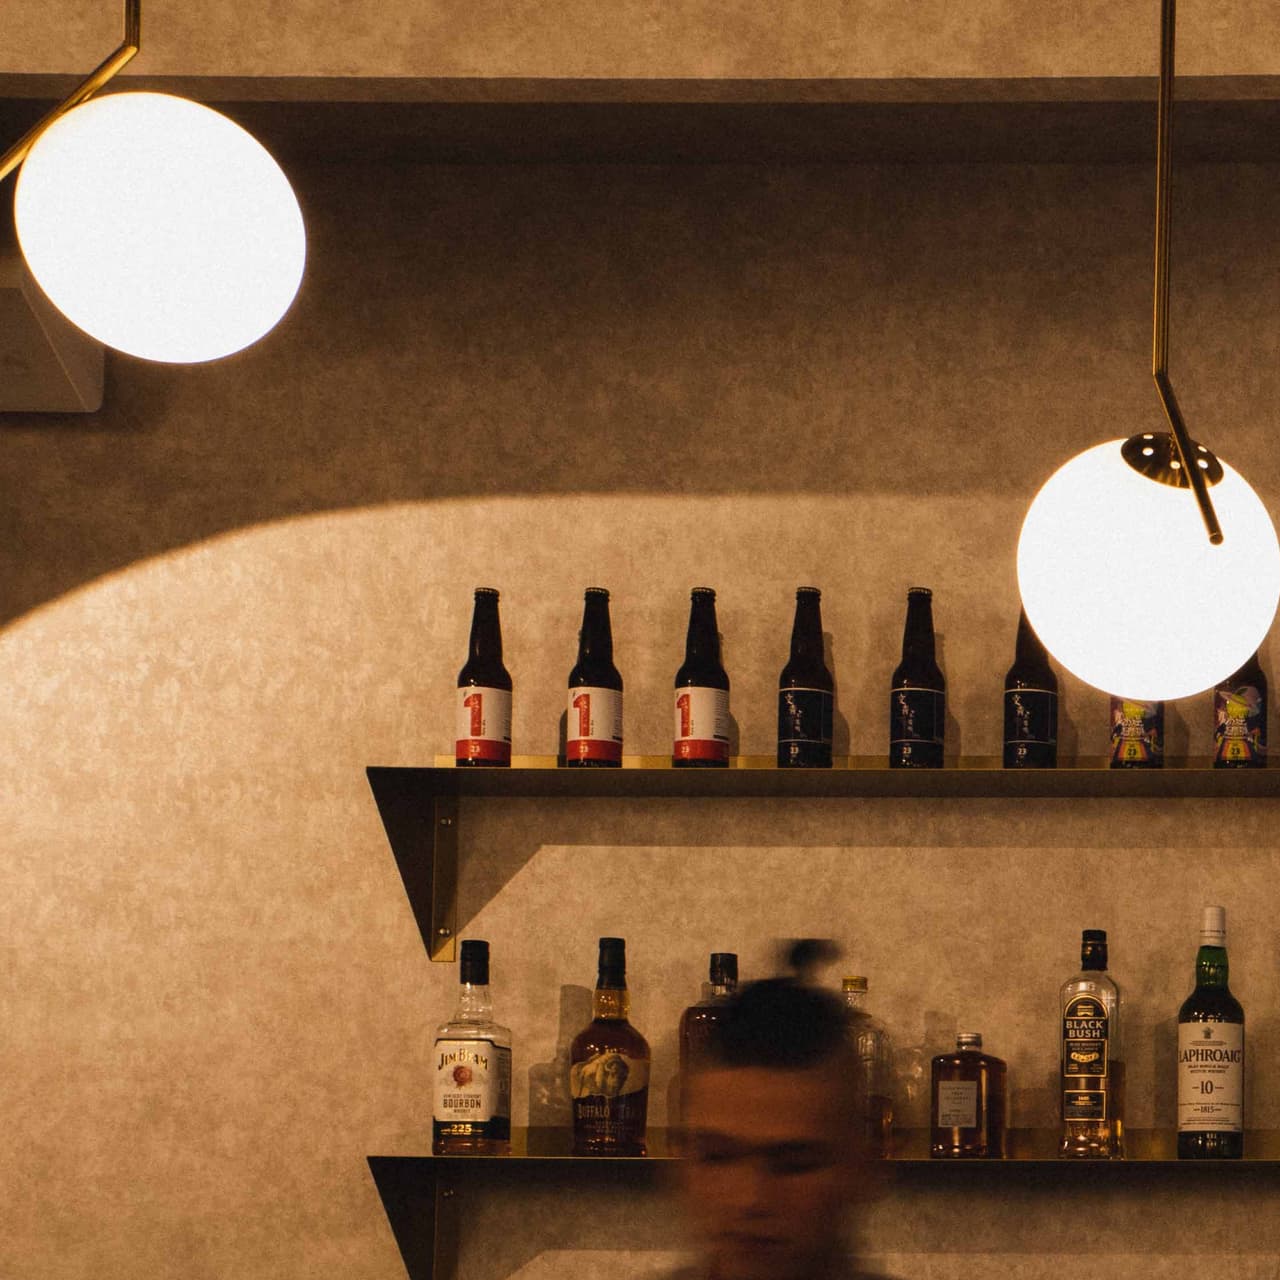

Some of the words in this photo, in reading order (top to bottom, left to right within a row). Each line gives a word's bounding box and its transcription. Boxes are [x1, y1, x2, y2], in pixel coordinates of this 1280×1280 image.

[1066, 1020, 1103, 1030] BLACK
[1069, 1030, 1100, 1038] BUSH
[438, 1053, 456, 1070] JIM
[458, 1048, 488, 1070] BEAM
[1179, 1049, 1241, 1063] LAPHROAIG
[1200, 1081, 1213, 1094] 10
[443, 1099, 481, 1109] BOURBON
[451, 1124, 473, 1133] 225
